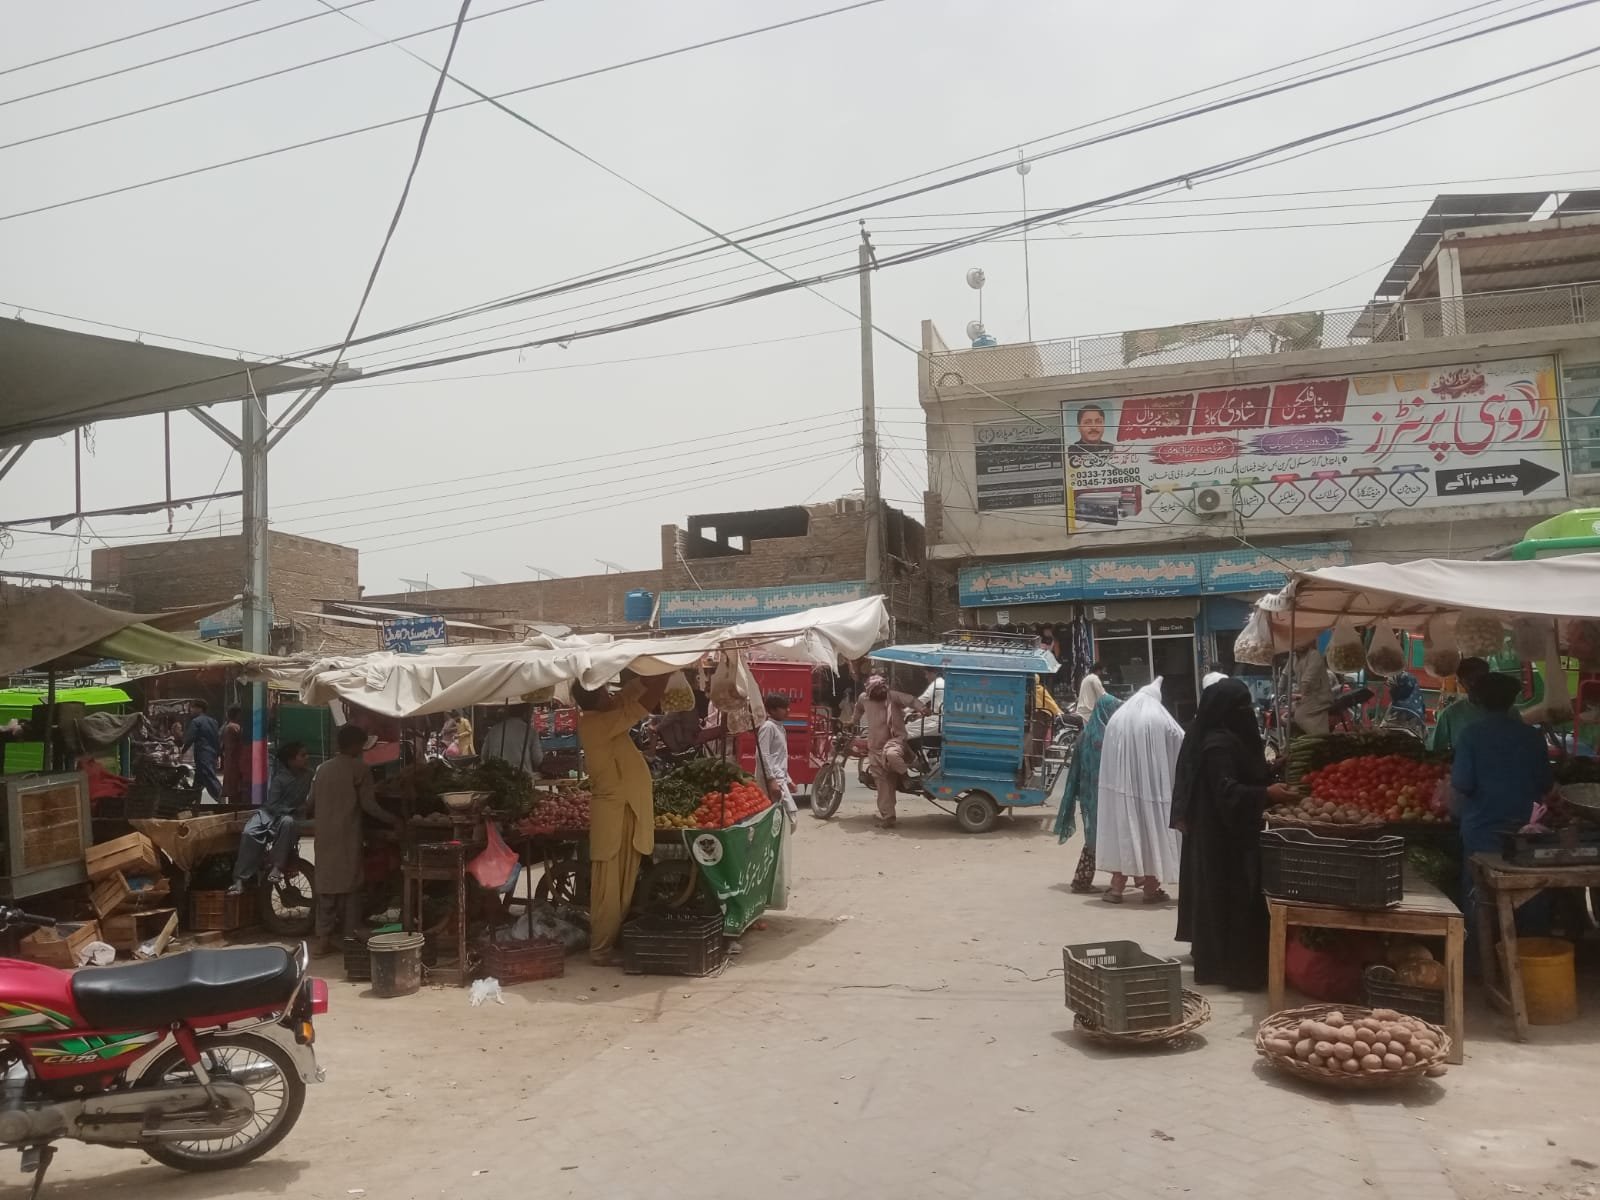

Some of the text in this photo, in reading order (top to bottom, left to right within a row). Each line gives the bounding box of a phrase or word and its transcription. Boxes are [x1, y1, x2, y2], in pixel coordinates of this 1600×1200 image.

[1361, 396, 1451, 463] پرنٹرز
[1445, 471, 1519, 491] چند قدم آگے
